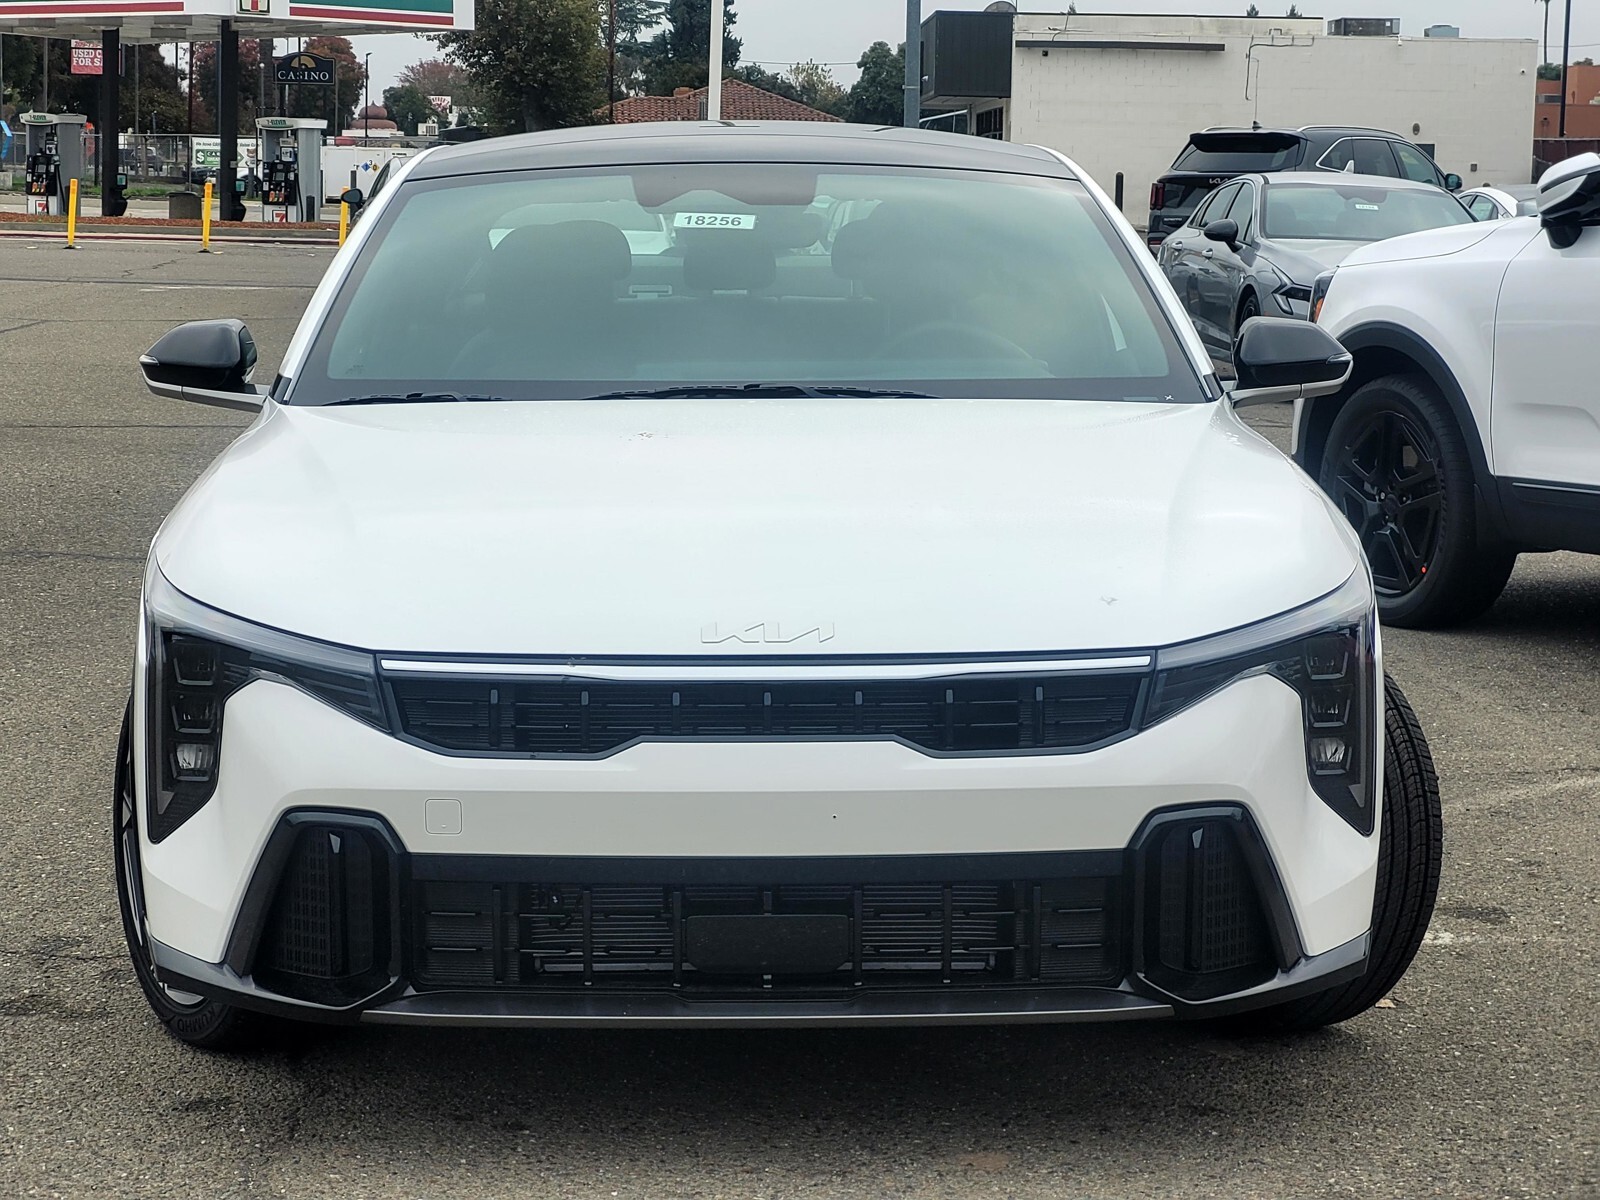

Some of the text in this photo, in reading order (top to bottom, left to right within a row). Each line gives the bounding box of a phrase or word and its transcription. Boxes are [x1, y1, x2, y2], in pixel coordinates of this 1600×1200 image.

[73, 49, 95, 58] USED
[73, 57, 91, 66] FOR
[277, 71, 329, 80] CASINO
[684, 215, 742, 226] 18256
[177, 1005, 217, 1033] KUMHO
